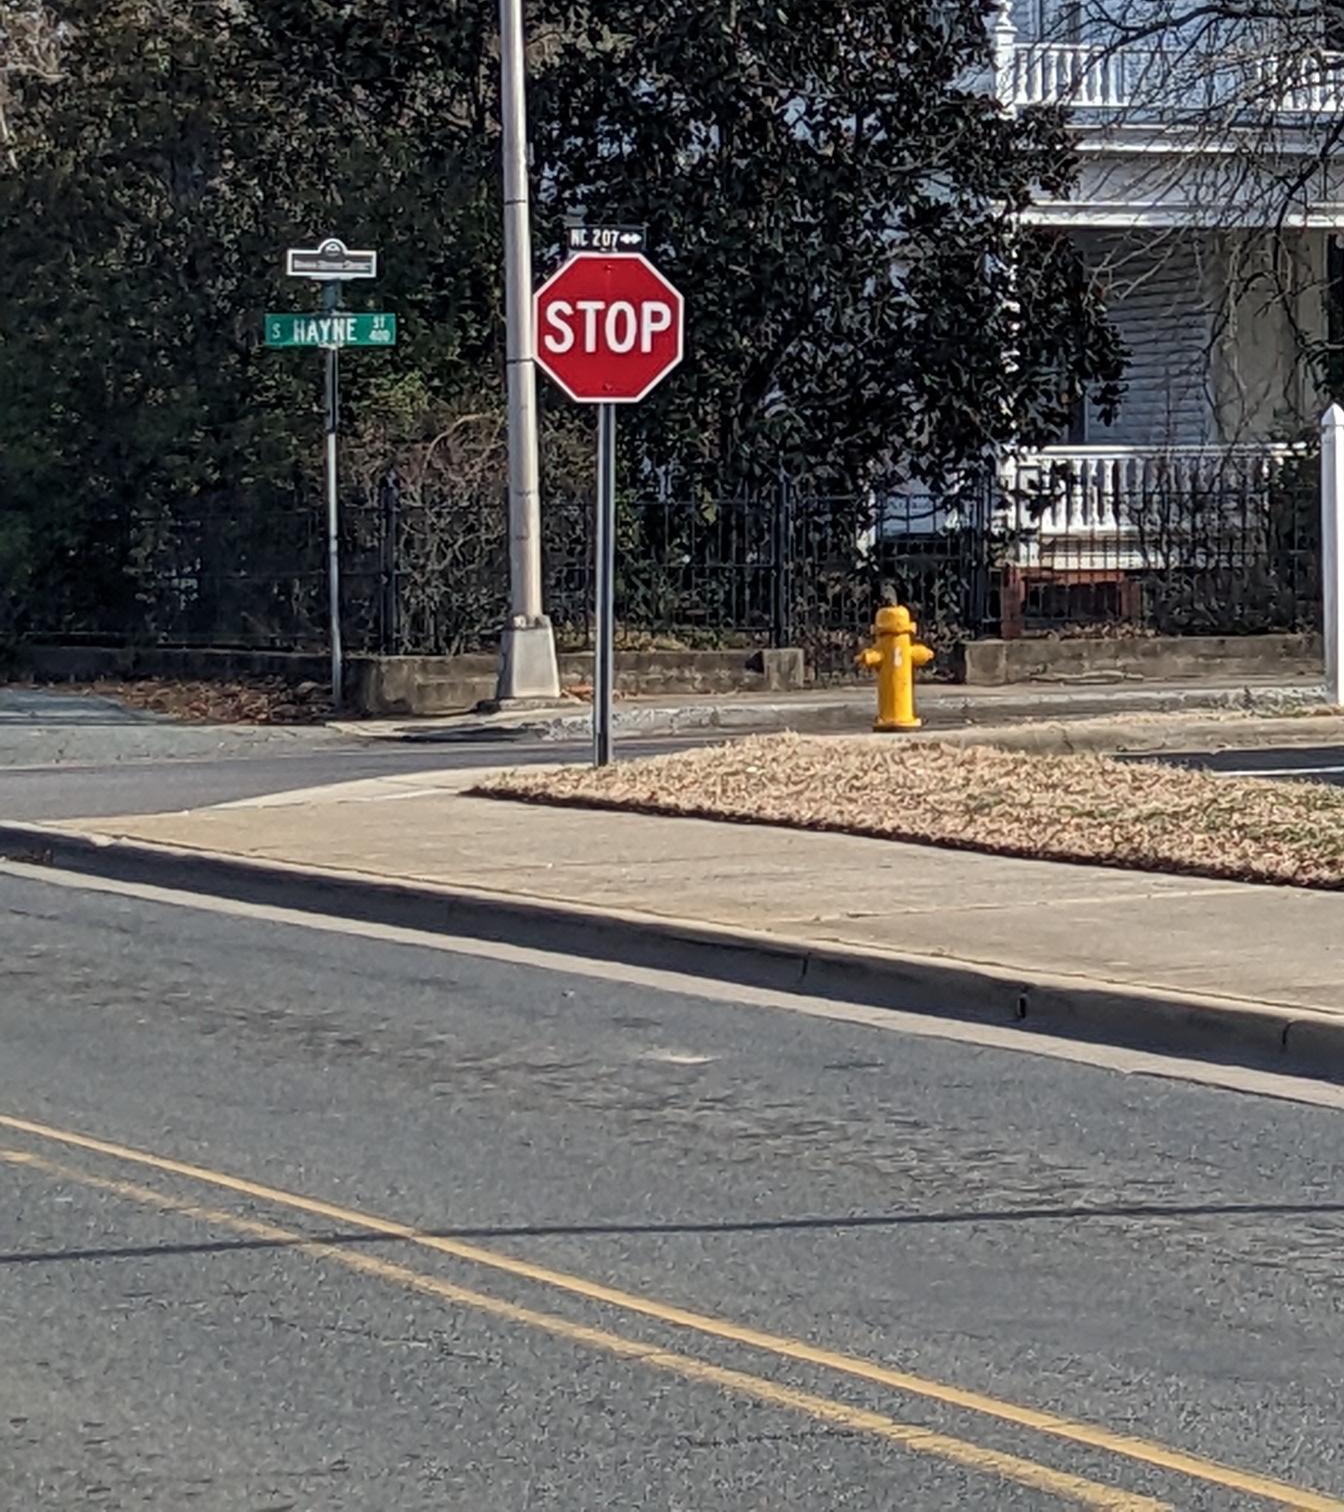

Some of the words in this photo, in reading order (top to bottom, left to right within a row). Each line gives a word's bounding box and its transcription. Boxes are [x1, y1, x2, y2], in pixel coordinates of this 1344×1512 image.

[571, 229, 588, 246] NC
[592, 229, 619, 246] 207
[272, 323, 281, 338] S
[293, 318, 358, 342] HAYNE
[373, 315, 387, 328] ST
[544, 301, 672, 354] STOP
